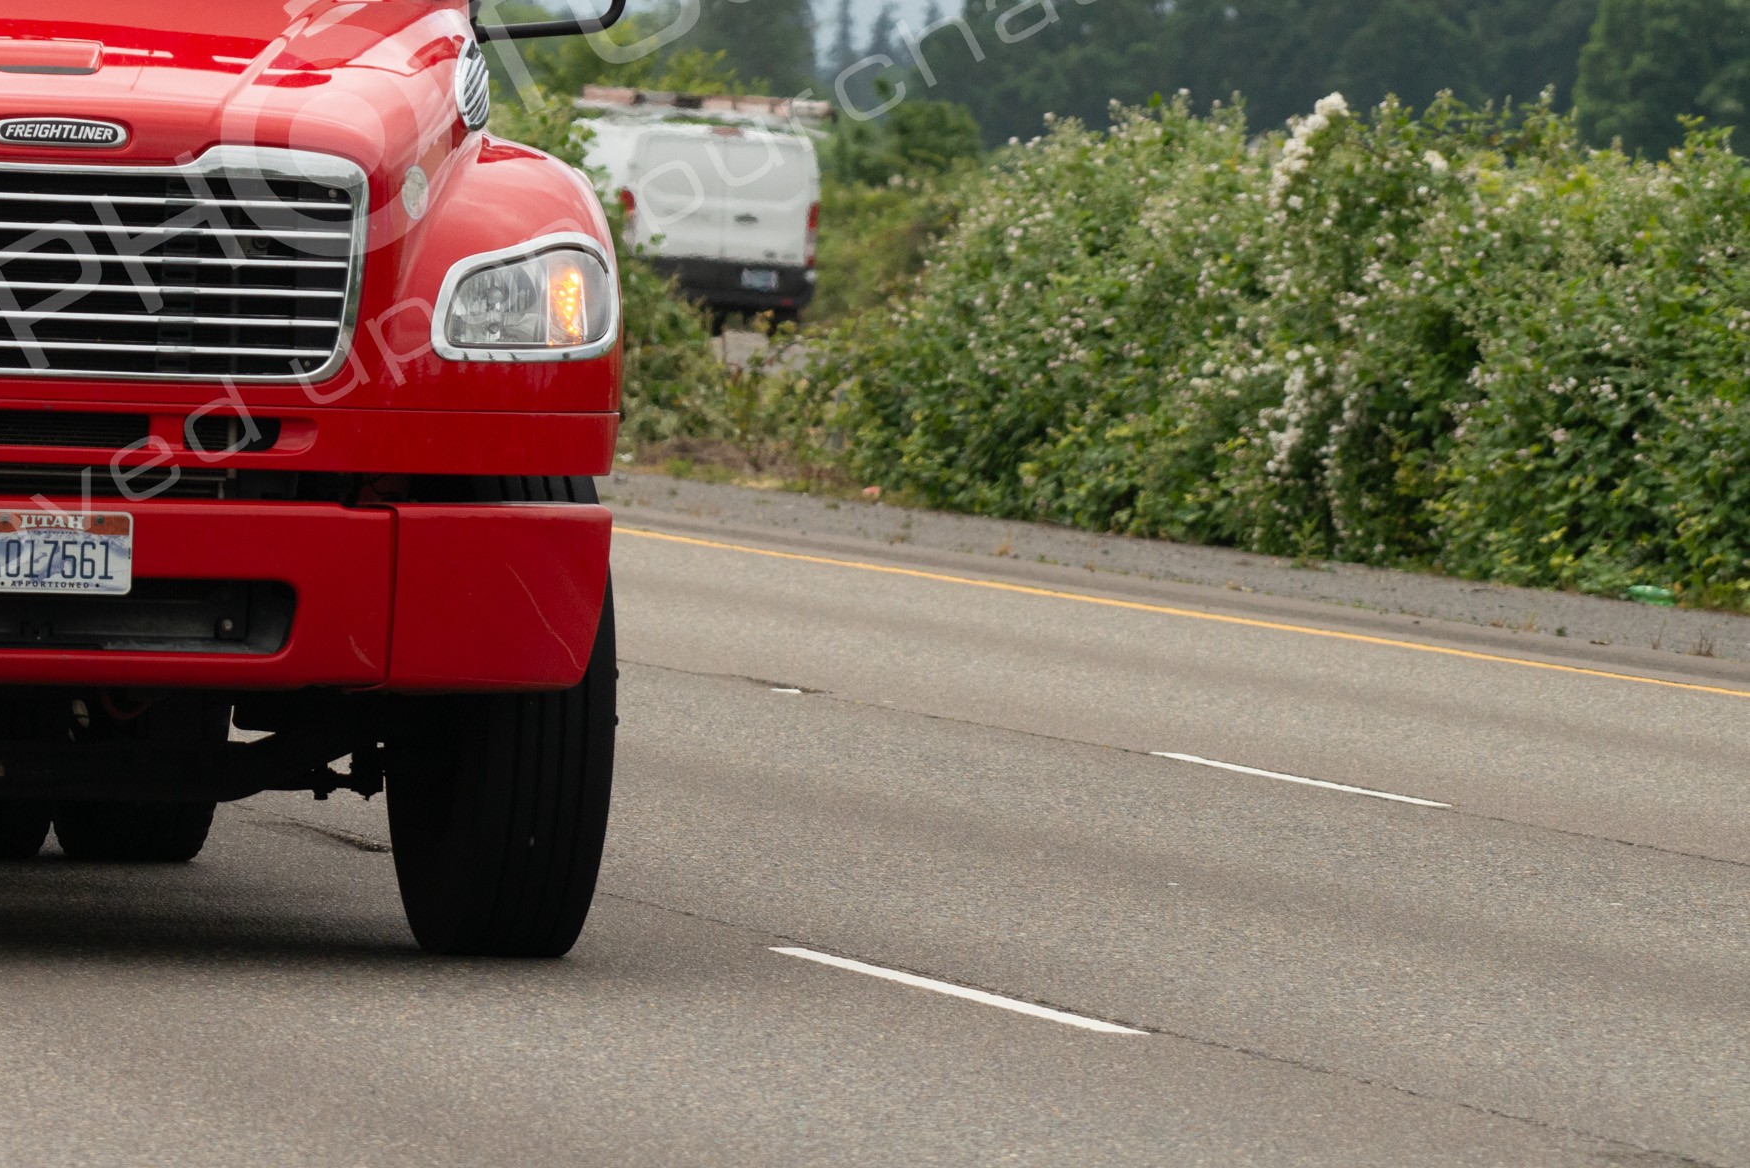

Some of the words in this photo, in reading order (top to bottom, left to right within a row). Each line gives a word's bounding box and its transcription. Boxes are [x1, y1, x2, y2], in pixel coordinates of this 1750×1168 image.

[5, 124, 113, 141] FREIGHTLINER
[20, 514, 85, 530] UTAH
[10, 580, 90, 589] APPORTIONED
